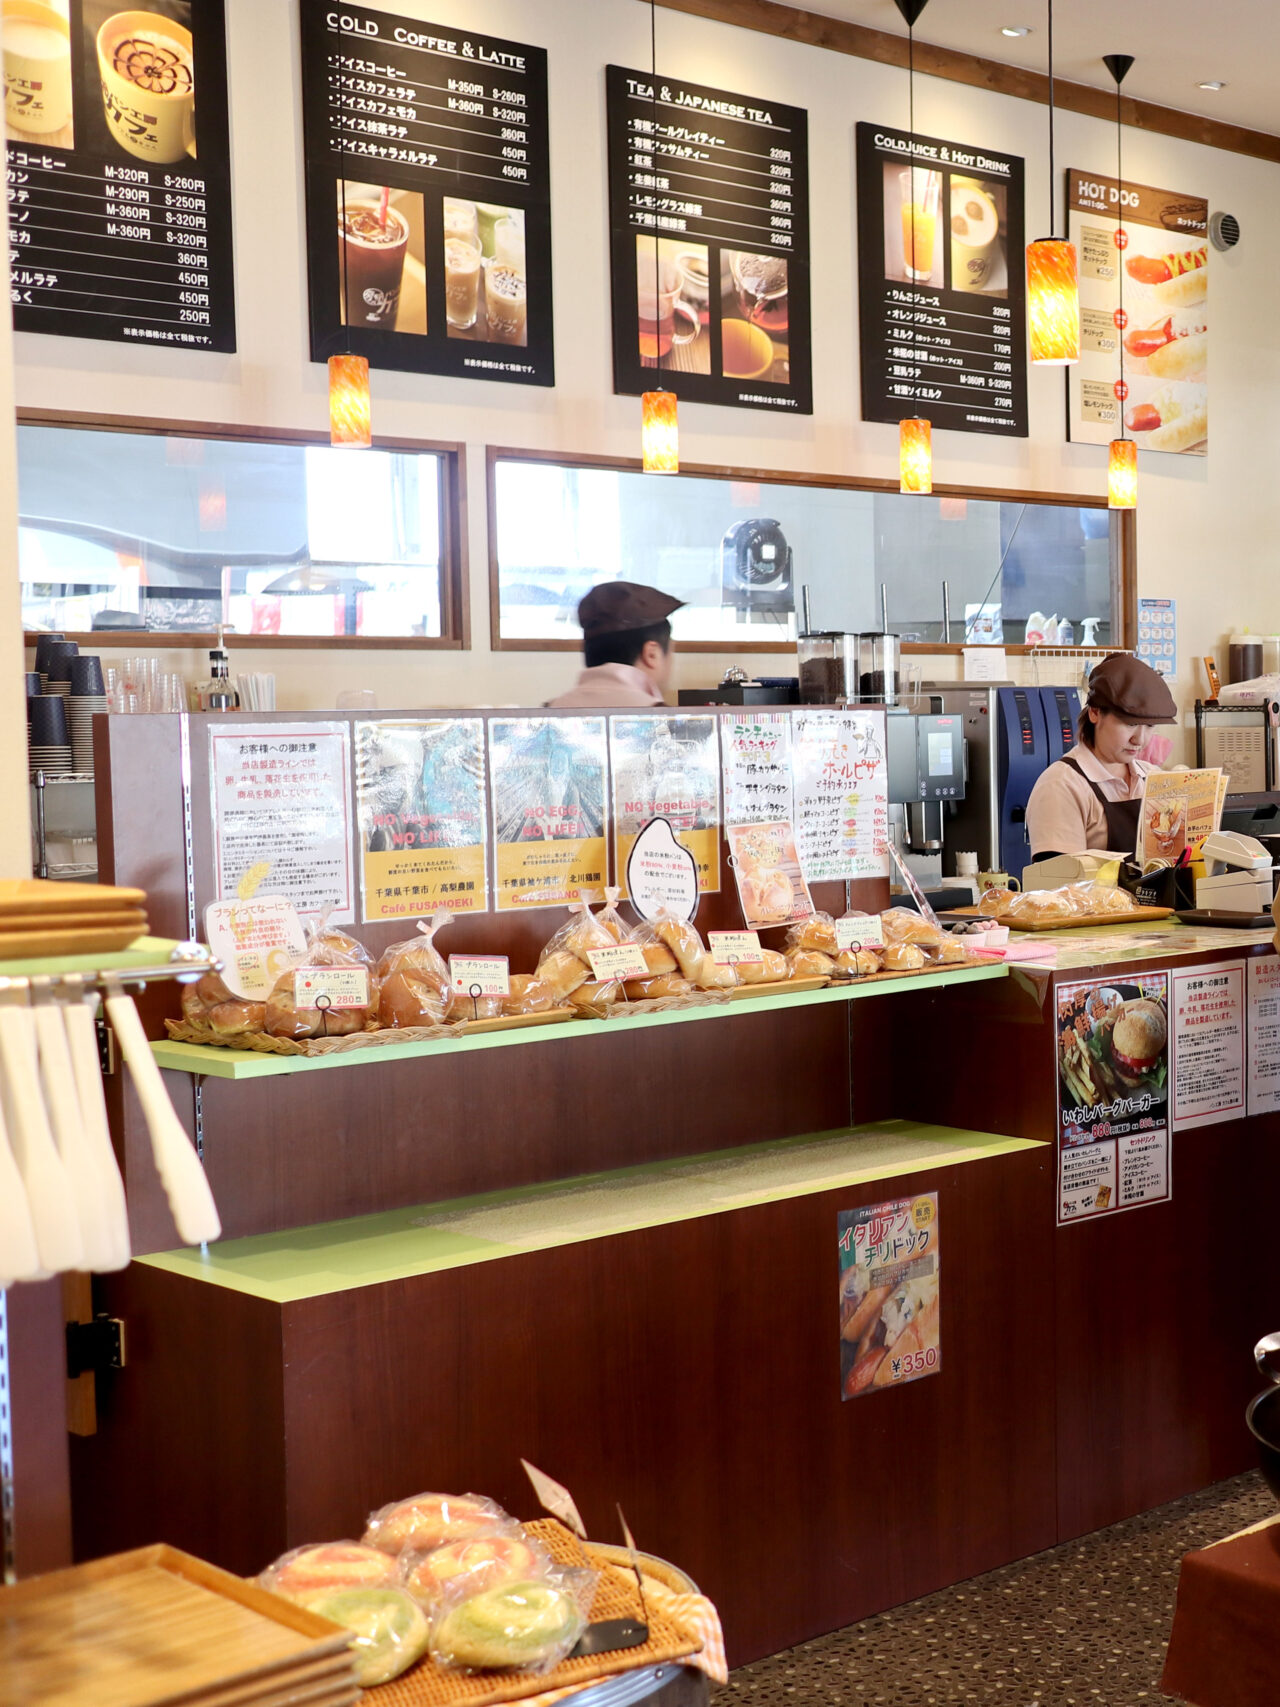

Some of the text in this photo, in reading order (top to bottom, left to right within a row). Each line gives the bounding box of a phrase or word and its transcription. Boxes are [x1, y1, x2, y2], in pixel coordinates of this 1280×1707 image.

[326, 12, 526, 69] COLD COFFEE & LATTE
[335, 54, 526, 105] アイスコーヒー M-350円 S-260円
[336, 74, 526, 123] アイスカフェラテ M-360円 S-320円
[626, 79, 773, 124] TEA & JAPANESE TEA
[336, 93, 526, 142] アイスカフェモカ 360円
[336, 114, 527, 161] アイス抹茶ラテ 450円
[337, 137, 527, 180] アイスキャラメルラテ 450円
[769, 147, 791, 162] 320円
[940, 147, 950, 161] &
[952, 150, 975, 166] HOT
[977, 156, 1011, 174] DRINK
[105, 165, 149, 184] M-320円
[164, 175, 205, 193] S-260円
[634, 153, 792, 196] 紅茶 320円
[769, 164, 792, 179] 320円
[106, 185, 150, 203] M-290円
[165, 194, 206, 212] S-250円
[1078, 180, 1140, 208] HOT DOG
[769, 198, 792, 213] 360円
[106, 203, 151, 221] M-360円
[166, 212, 207, 230] S-320円
[770, 215, 792, 230] 360円
[107, 223, 151, 241] M-360円
[166, 231, 207, 248] S-320円
[770, 232, 792, 247] 320円
[177, 252, 208, 268] 360円
[178, 271, 209, 287] 450円
[179, 291, 209, 307] 450円
[892, 289, 1011, 318] りんごジュース 320円
[179, 309, 210, 325] 250円
[892, 309, 1011, 337] オレンジジュース 320円
[892, 328, 914, 340] ミルク
[239, 742, 318, 755] お客様への御注意
[822, 759, 881, 780] ホールピザ
[525, 806, 544, 817] NO
[625, 802, 643, 812] NO
[373, 813, 397, 826] NO
[392, 832, 416, 845] NO
[522, 825, 542, 837] NO
[376, 885, 429, 898] 千葉県千葉市
[409, 898, 473, 912] FUSANOEKI
[1187, 977, 1229, 990] お客様への御注意
[1062, 1093, 1161, 1126] いわしバーグバーガー
[860, 1207, 881, 1218] ITALIAN
[839, 1212, 909, 1252] イタリアン
[865, 1230, 929, 1268] チリドック
[892, 1348, 937, 1374] ¥350
